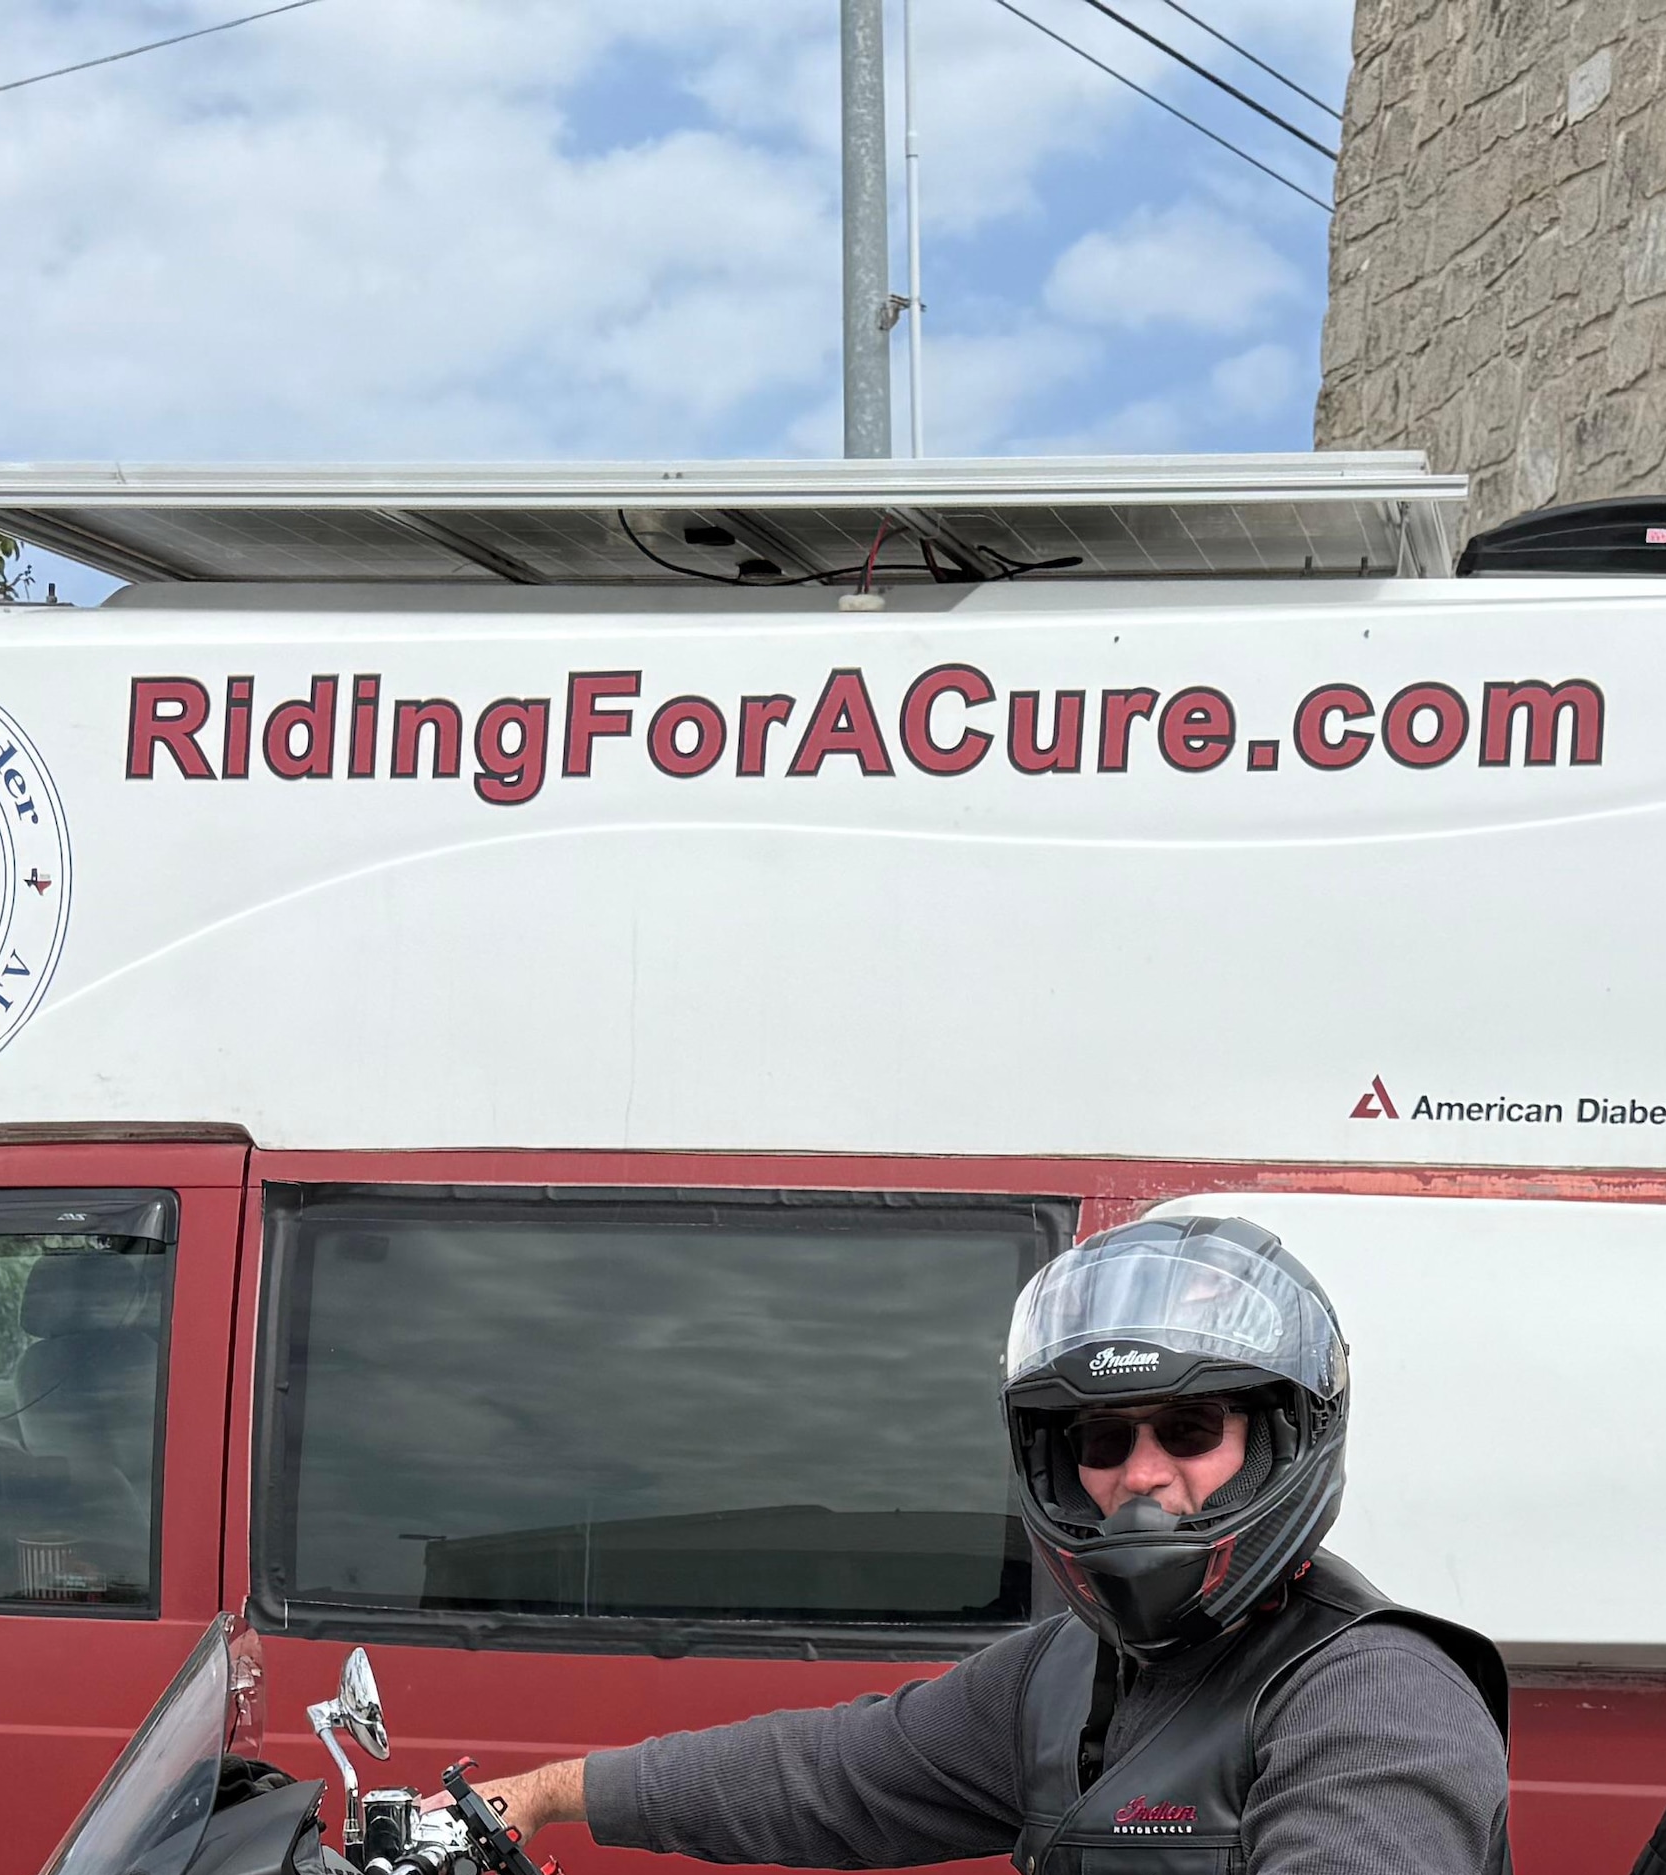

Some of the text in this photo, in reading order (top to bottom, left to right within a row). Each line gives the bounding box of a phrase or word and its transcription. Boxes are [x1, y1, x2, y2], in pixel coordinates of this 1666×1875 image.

[125, 664, 1607, 805] RidingForACure.com
[1411, 1095, 1563, 1124] American
[1089, 1346, 1160, 1371] Indian
[1114, 1794, 1199, 1823] Indian
[1113, 1825, 1193, 1835] MOTORCYCLE
